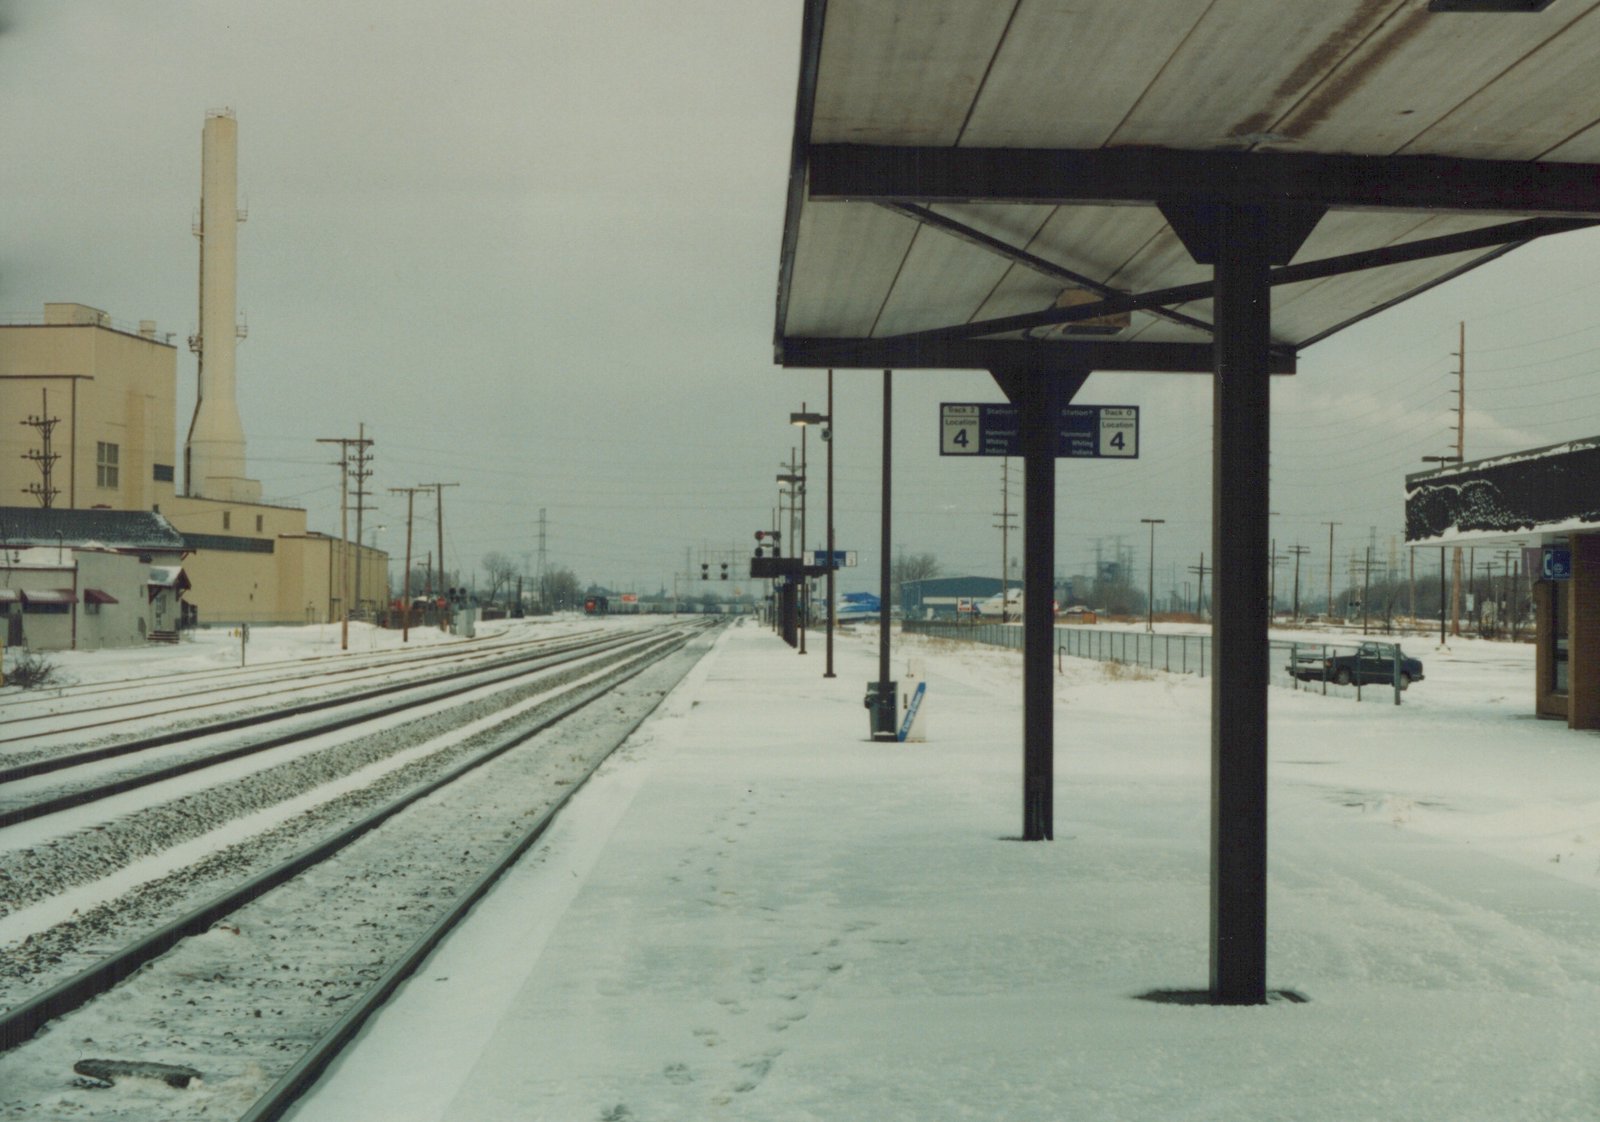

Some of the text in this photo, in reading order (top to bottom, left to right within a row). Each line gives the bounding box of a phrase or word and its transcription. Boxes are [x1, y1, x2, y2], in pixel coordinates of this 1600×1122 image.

[945, 418, 977, 426] Location
[1102, 421, 1134, 429] Location
[953, 428, 969, 448] 4
[1109, 432, 1126, 451] 4
